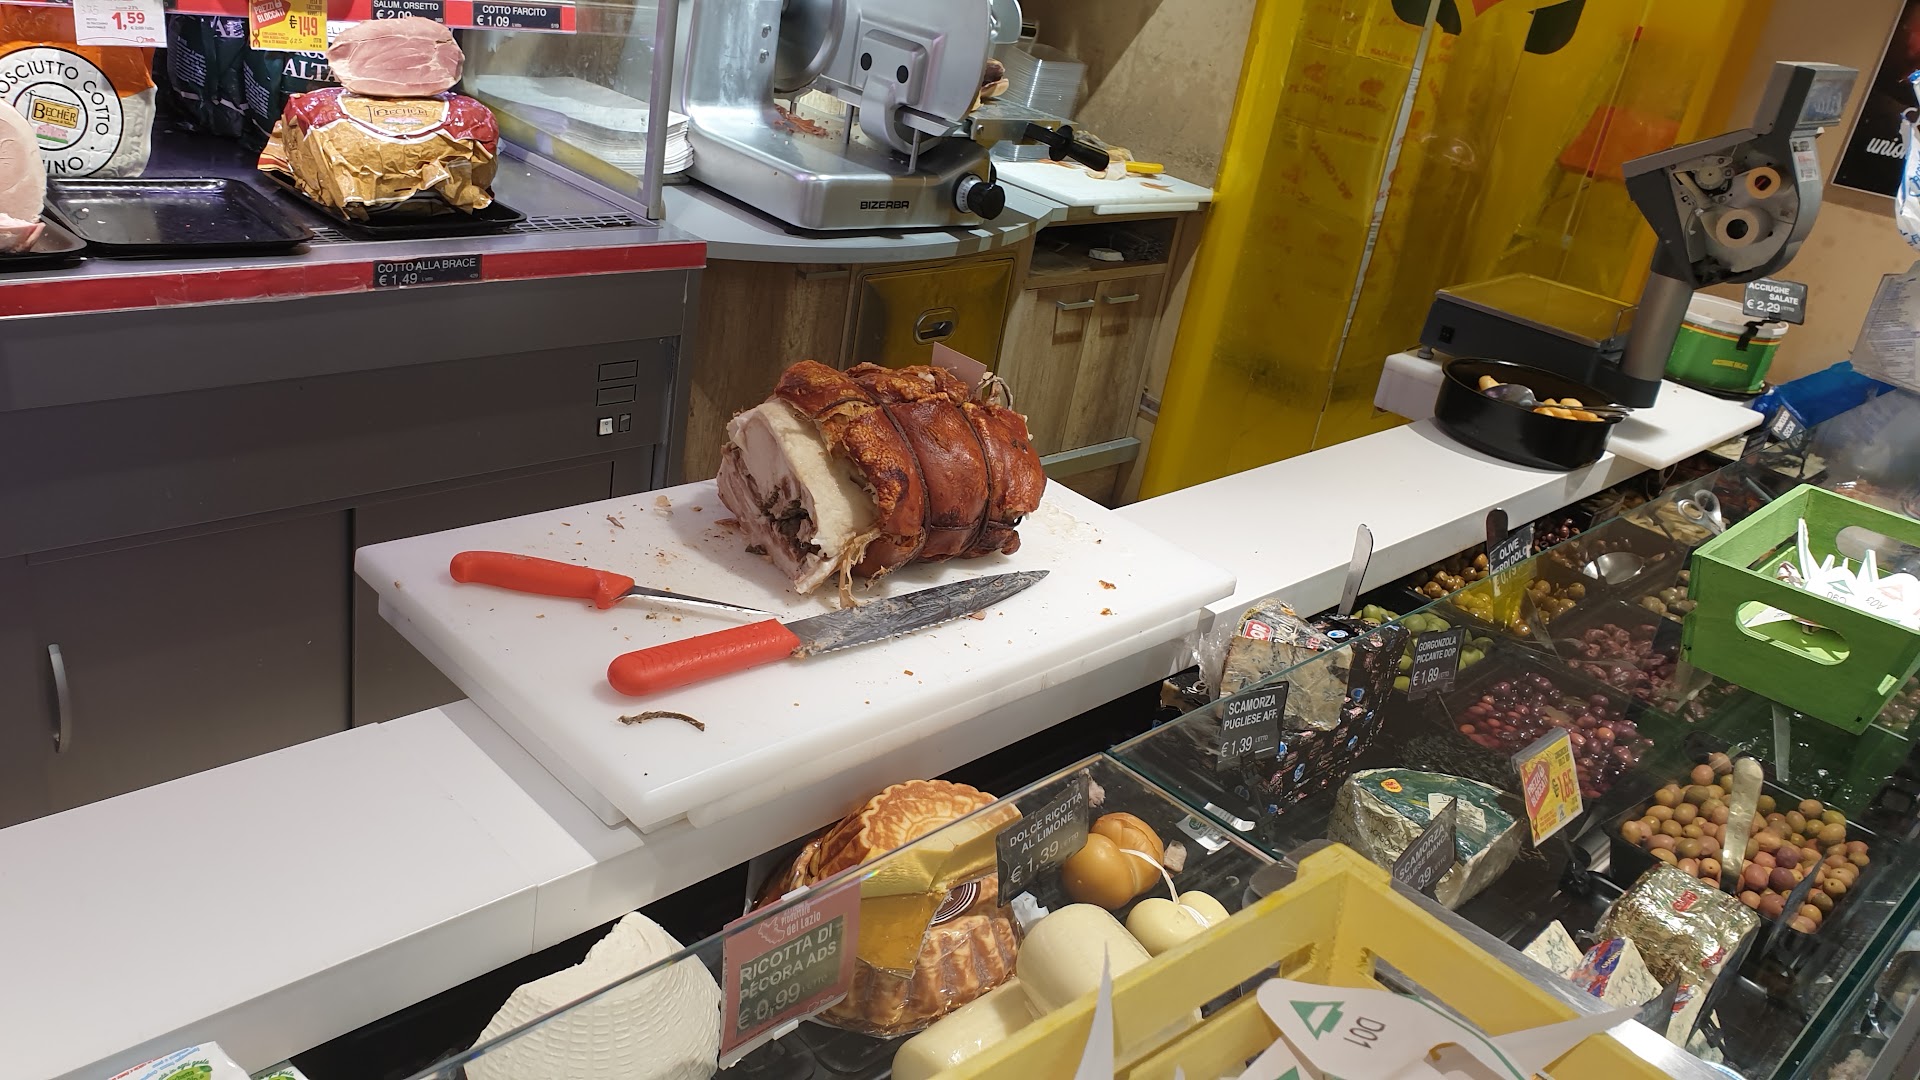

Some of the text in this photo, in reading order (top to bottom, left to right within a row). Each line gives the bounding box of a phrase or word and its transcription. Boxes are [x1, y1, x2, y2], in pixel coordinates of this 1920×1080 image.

[253, 1, 275, 14] PREZZI
[257, 8, 285, 23] BLOCCATI
[376, 10, 384, 20] €
[404, 1, 439, 11] ORSETTO
[482, 5, 547, 17] COTTO FARCITO
[111, 11, 145, 30] 1,59
[289, 15, 297, 29] €
[298, 16, 318, 37] 1,49
[476, 15, 484, 26] €
[487, 16, 510, 28] 1,09
[0, 60, 111, 135] OSCIUTTO COTTO
[1866, 137, 1906, 160] unio
[42, 156, 84, 175] INO
[860, 200, 910, 210] BIZERBA
[377, 258, 476, 274] COTTO ALLA BRACE
[378, 274, 387, 286] €
[392, 273, 418, 286] 1,49
[1748, 282, 1790, 295] ACCIUGHE
[1746, 299, 1755, 309] €
[1756, 301, 1781, 313] 2,29
[1769, 293, 1799, 306] SALATE
[1500, 537, 1520, 560] OLIVE
[1418, 636, 1457, 652] GORGONZOLA
[1415, 648, 1457, 664] PICCANTE DOP
[1412, 671, 1420, 686] €
[1421, 667, 1440, 686] 1,89
[1228, 694, 1276, 716] SCAMORZA
[1224, 708, 1278, 731] PUGLIESE AFF.
[1220, 741, 1229, 758] €
[1231, 736, 1253, 756] 1,39
[1009, 792, 1083, 847] DOLCE RICOTTA
[1021, 810, 1074, 854] AL LIMONE
[1399, 823, 1445, 880] SCAMORZA
[1426, 831, 1449, 860] BIANCA
[1010, 865, 1022, 883] €
[1027, 840, 1059, 873] 1,39
[786, 911, 821, 936] del Lazio
[740, 923, 833, 984] RICOTTA DI
[740, 941, 837, 1004] PECORA ADS
[738, 1008, 750, 1030] €
[756, 983, 800, 1020] 0,99
[1343, 1016, 1386, 1050] D01
